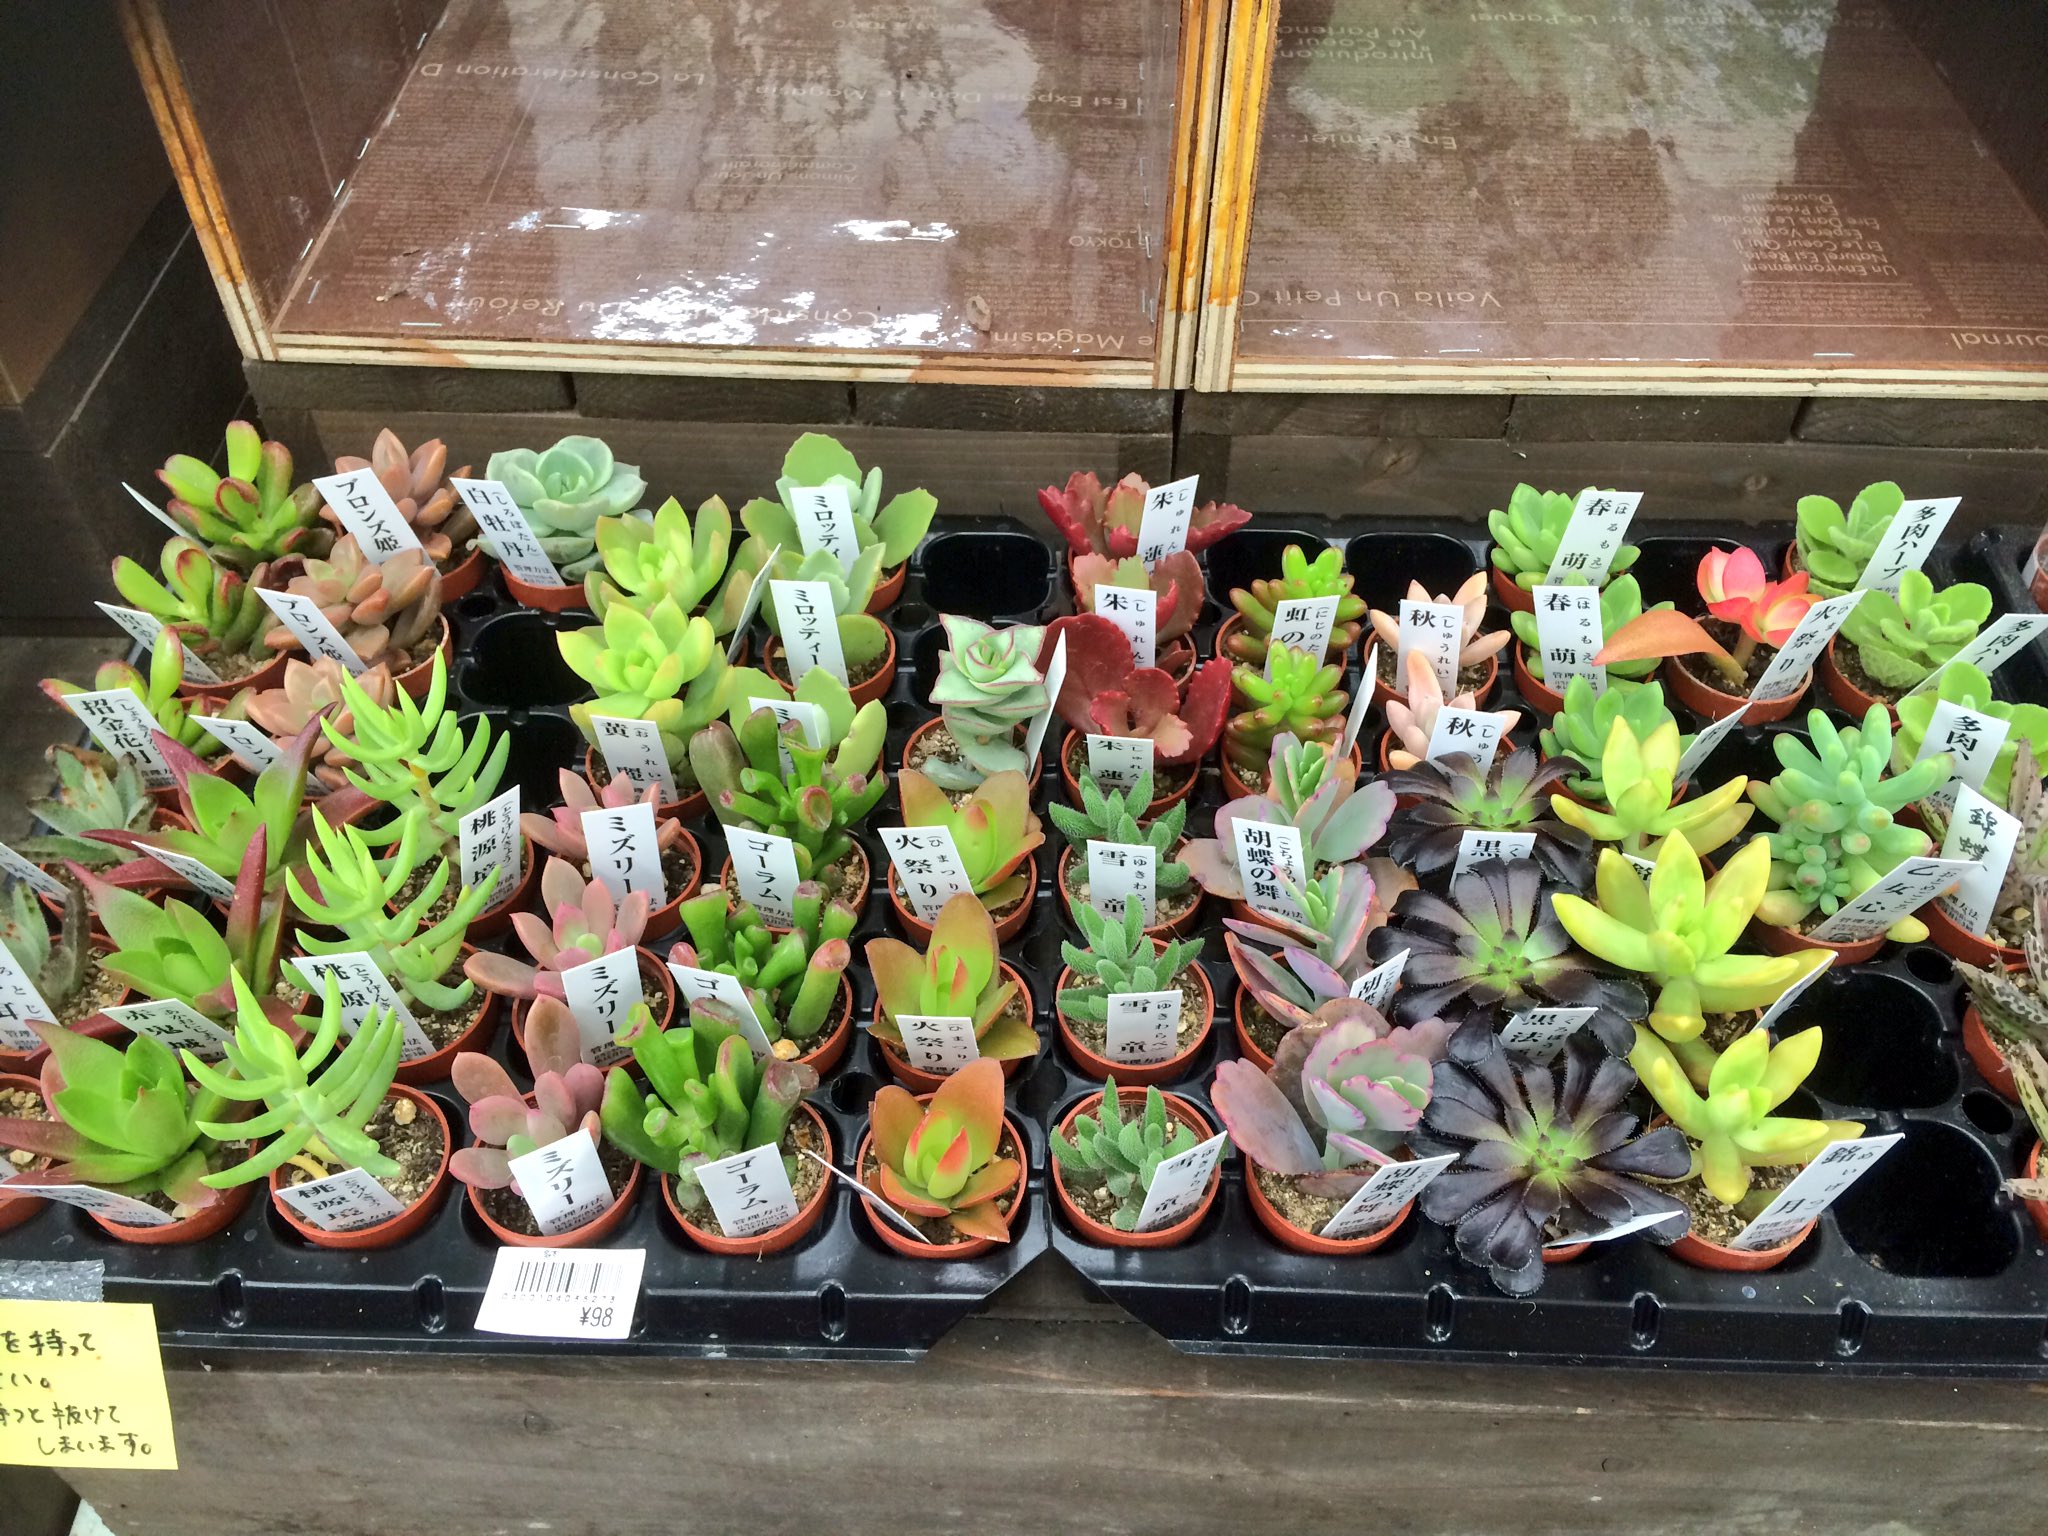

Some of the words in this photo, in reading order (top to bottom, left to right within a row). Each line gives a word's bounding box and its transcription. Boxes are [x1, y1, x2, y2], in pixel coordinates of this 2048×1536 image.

[1295, 38, 1376, 51] Coeur
[673, 72, 705, 86] La
[1093, 97, 1128, 110] Est
[1422, 135, 1458, 150] En
[1068, 235, 1134, 249] TOKYO
[1711, 215, 1770, 227] Monde
[1799, 217, 1843, 229] Dans
[1787, 240, 1838, 252] Coeur
[1794, 251, 1819, 263] Est
[1841, 241, 1863, 251] Le
[1868, 241, 1883, 252] Et
[1743, 262, 1868, 276] Environnement
[1872, 264, 1898, 276] Un
[1274, 289, 1342, 306] Petit
[1356, 290, 1401, 308] Un
[1414, 290, 1503, 308] Voilà
[992, 328, 1125, 350] Magasin
[335, 476, 403, 552] ブロンズ姫
[466, 488, 523, 558] 白牡丹
[814, 495, 840, 559] ミロッティ
[1561, 497, 1612, 571] 春萌
[1883, 504, 1939, 580] 多肉ハーブ
[1281, 606, 1312, 644] 虹の
[1307, 606, 1330, 652] (にじのた
[1543, 592, 1577, 666] 春萌
[1779, 605, 1837, 673] 火祭り
[1972, 620, 2036, 665] 多肉ハー
[608, 816, 636, 894] ミズリー
[747, 838, 782, 902] ゴーラム
[895, 834, 937, 898] 火祭り
[1242, 827, 1280, 901] 胡蝶の舞
[1855, 864, 1940, 914] 乙女心
[592, 966, 619, 1034] ミズリー
[912, 1020, 945, 1062] 火祭り
[1119, 999, 1152, 1055] 雪童
[542, 1149, 574, 1206] ミズリー
[725, 1156, 768, 1210] ゴーラム
[1352, 1165, 1422, 1216] 胡蝶の舞
[1774, 1145, 1864, 1215] 銘月
[579, 1306, 614, 1327] ¥98
[37, 1432, 153, 1457] しまいます。
